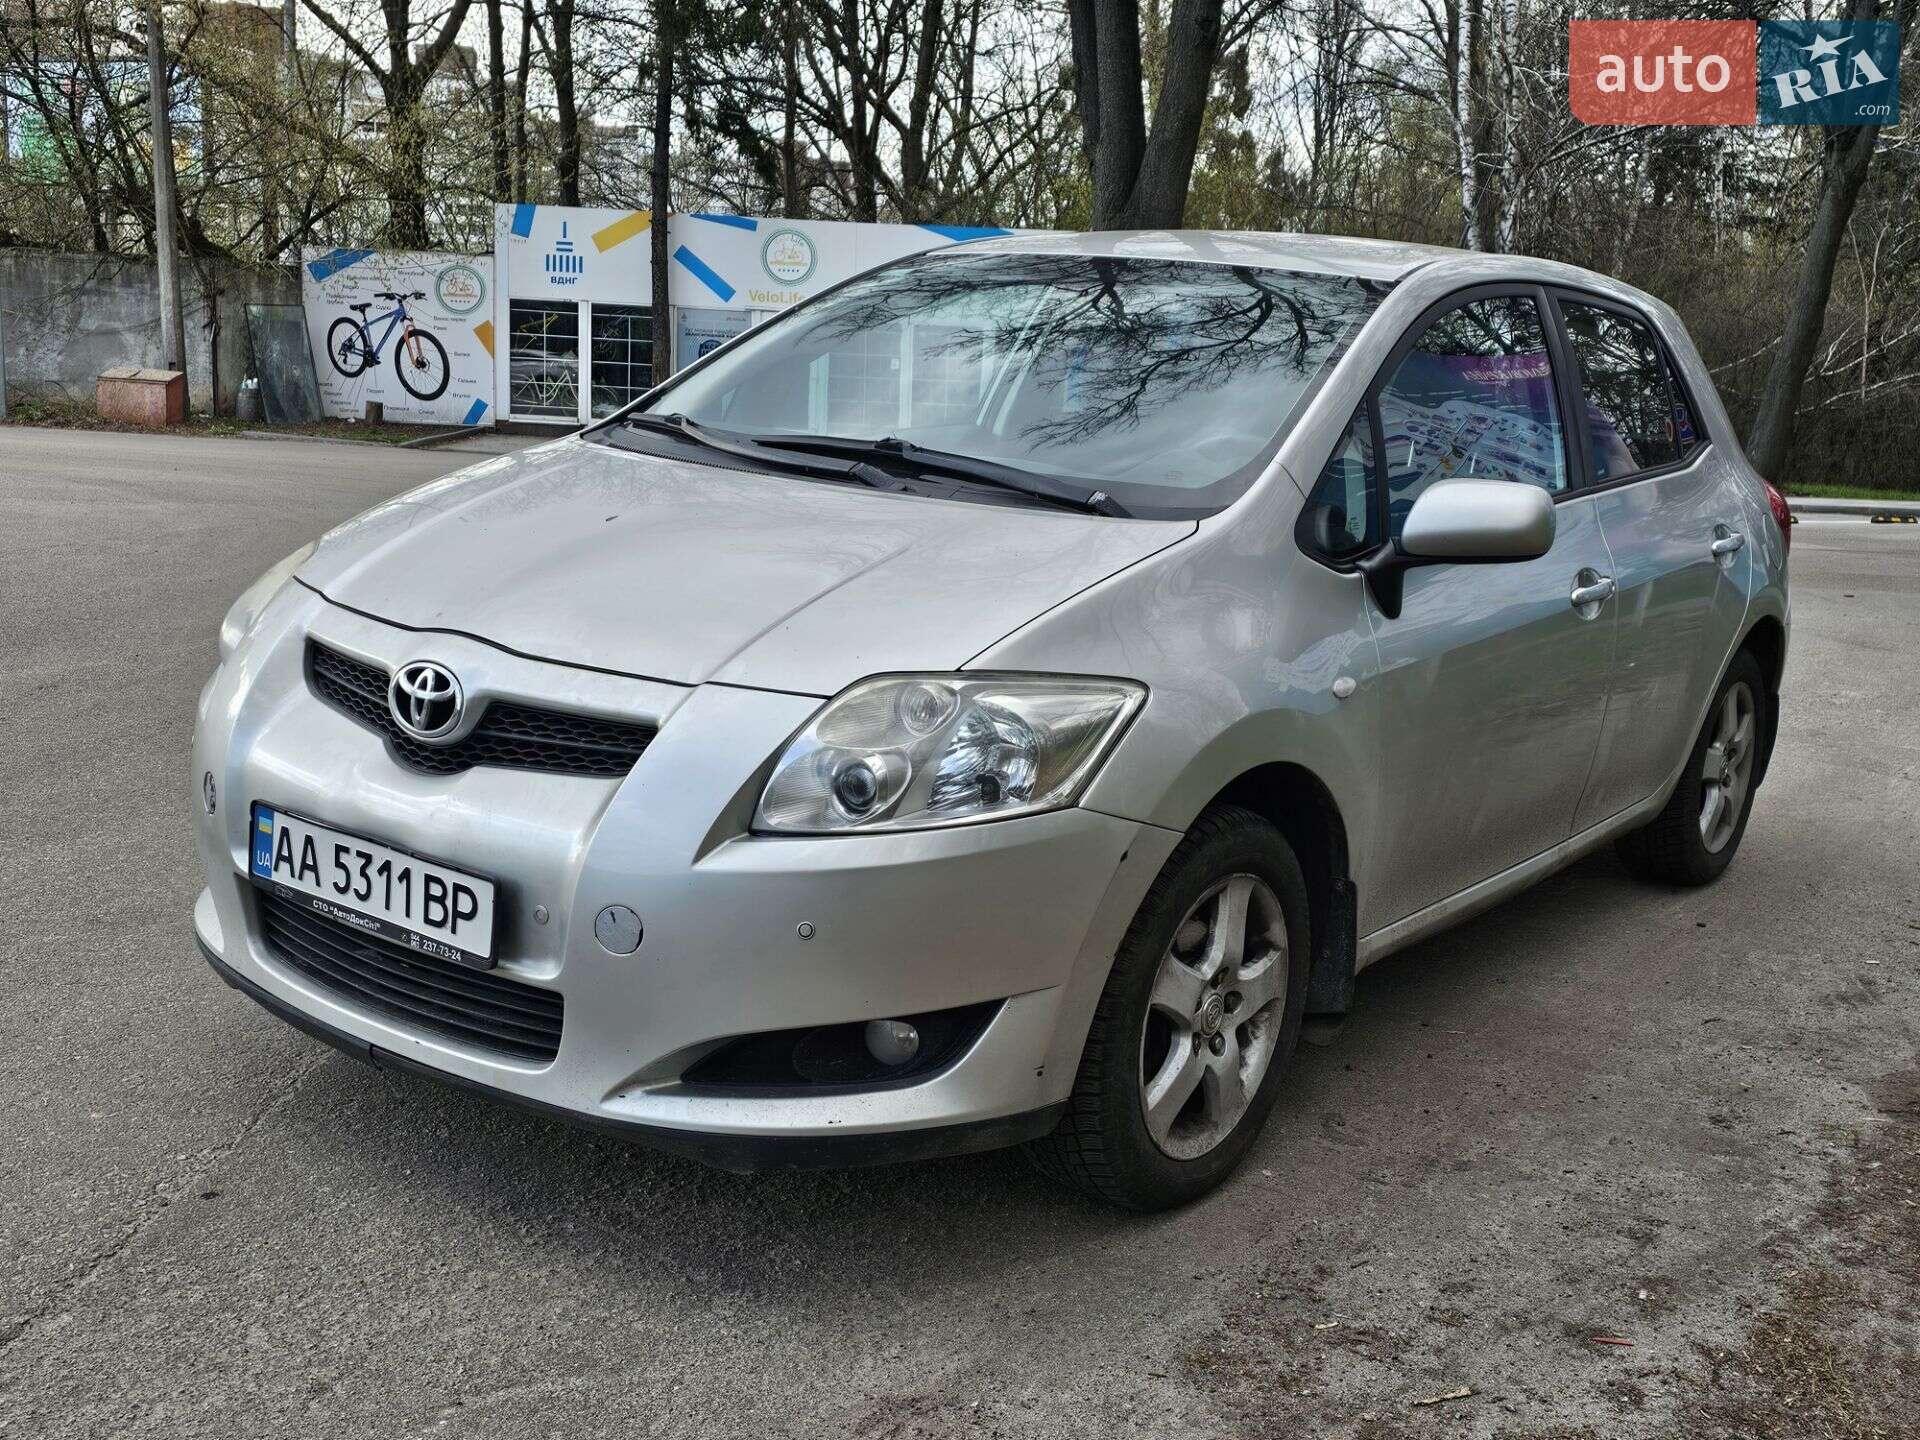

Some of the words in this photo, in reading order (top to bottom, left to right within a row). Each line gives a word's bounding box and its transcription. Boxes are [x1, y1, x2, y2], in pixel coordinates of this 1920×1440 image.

[550, 276, 578, 285] ВДНГ
[257, 850, 272, 869] UA
[273, 825, 321, 887] AA
[332, 843, 412, 919] 5311
[423, 872, 479, 935] BP
[313, 899, 329, 912] СТО
[423, 939, 462, 962] 237-73-24
